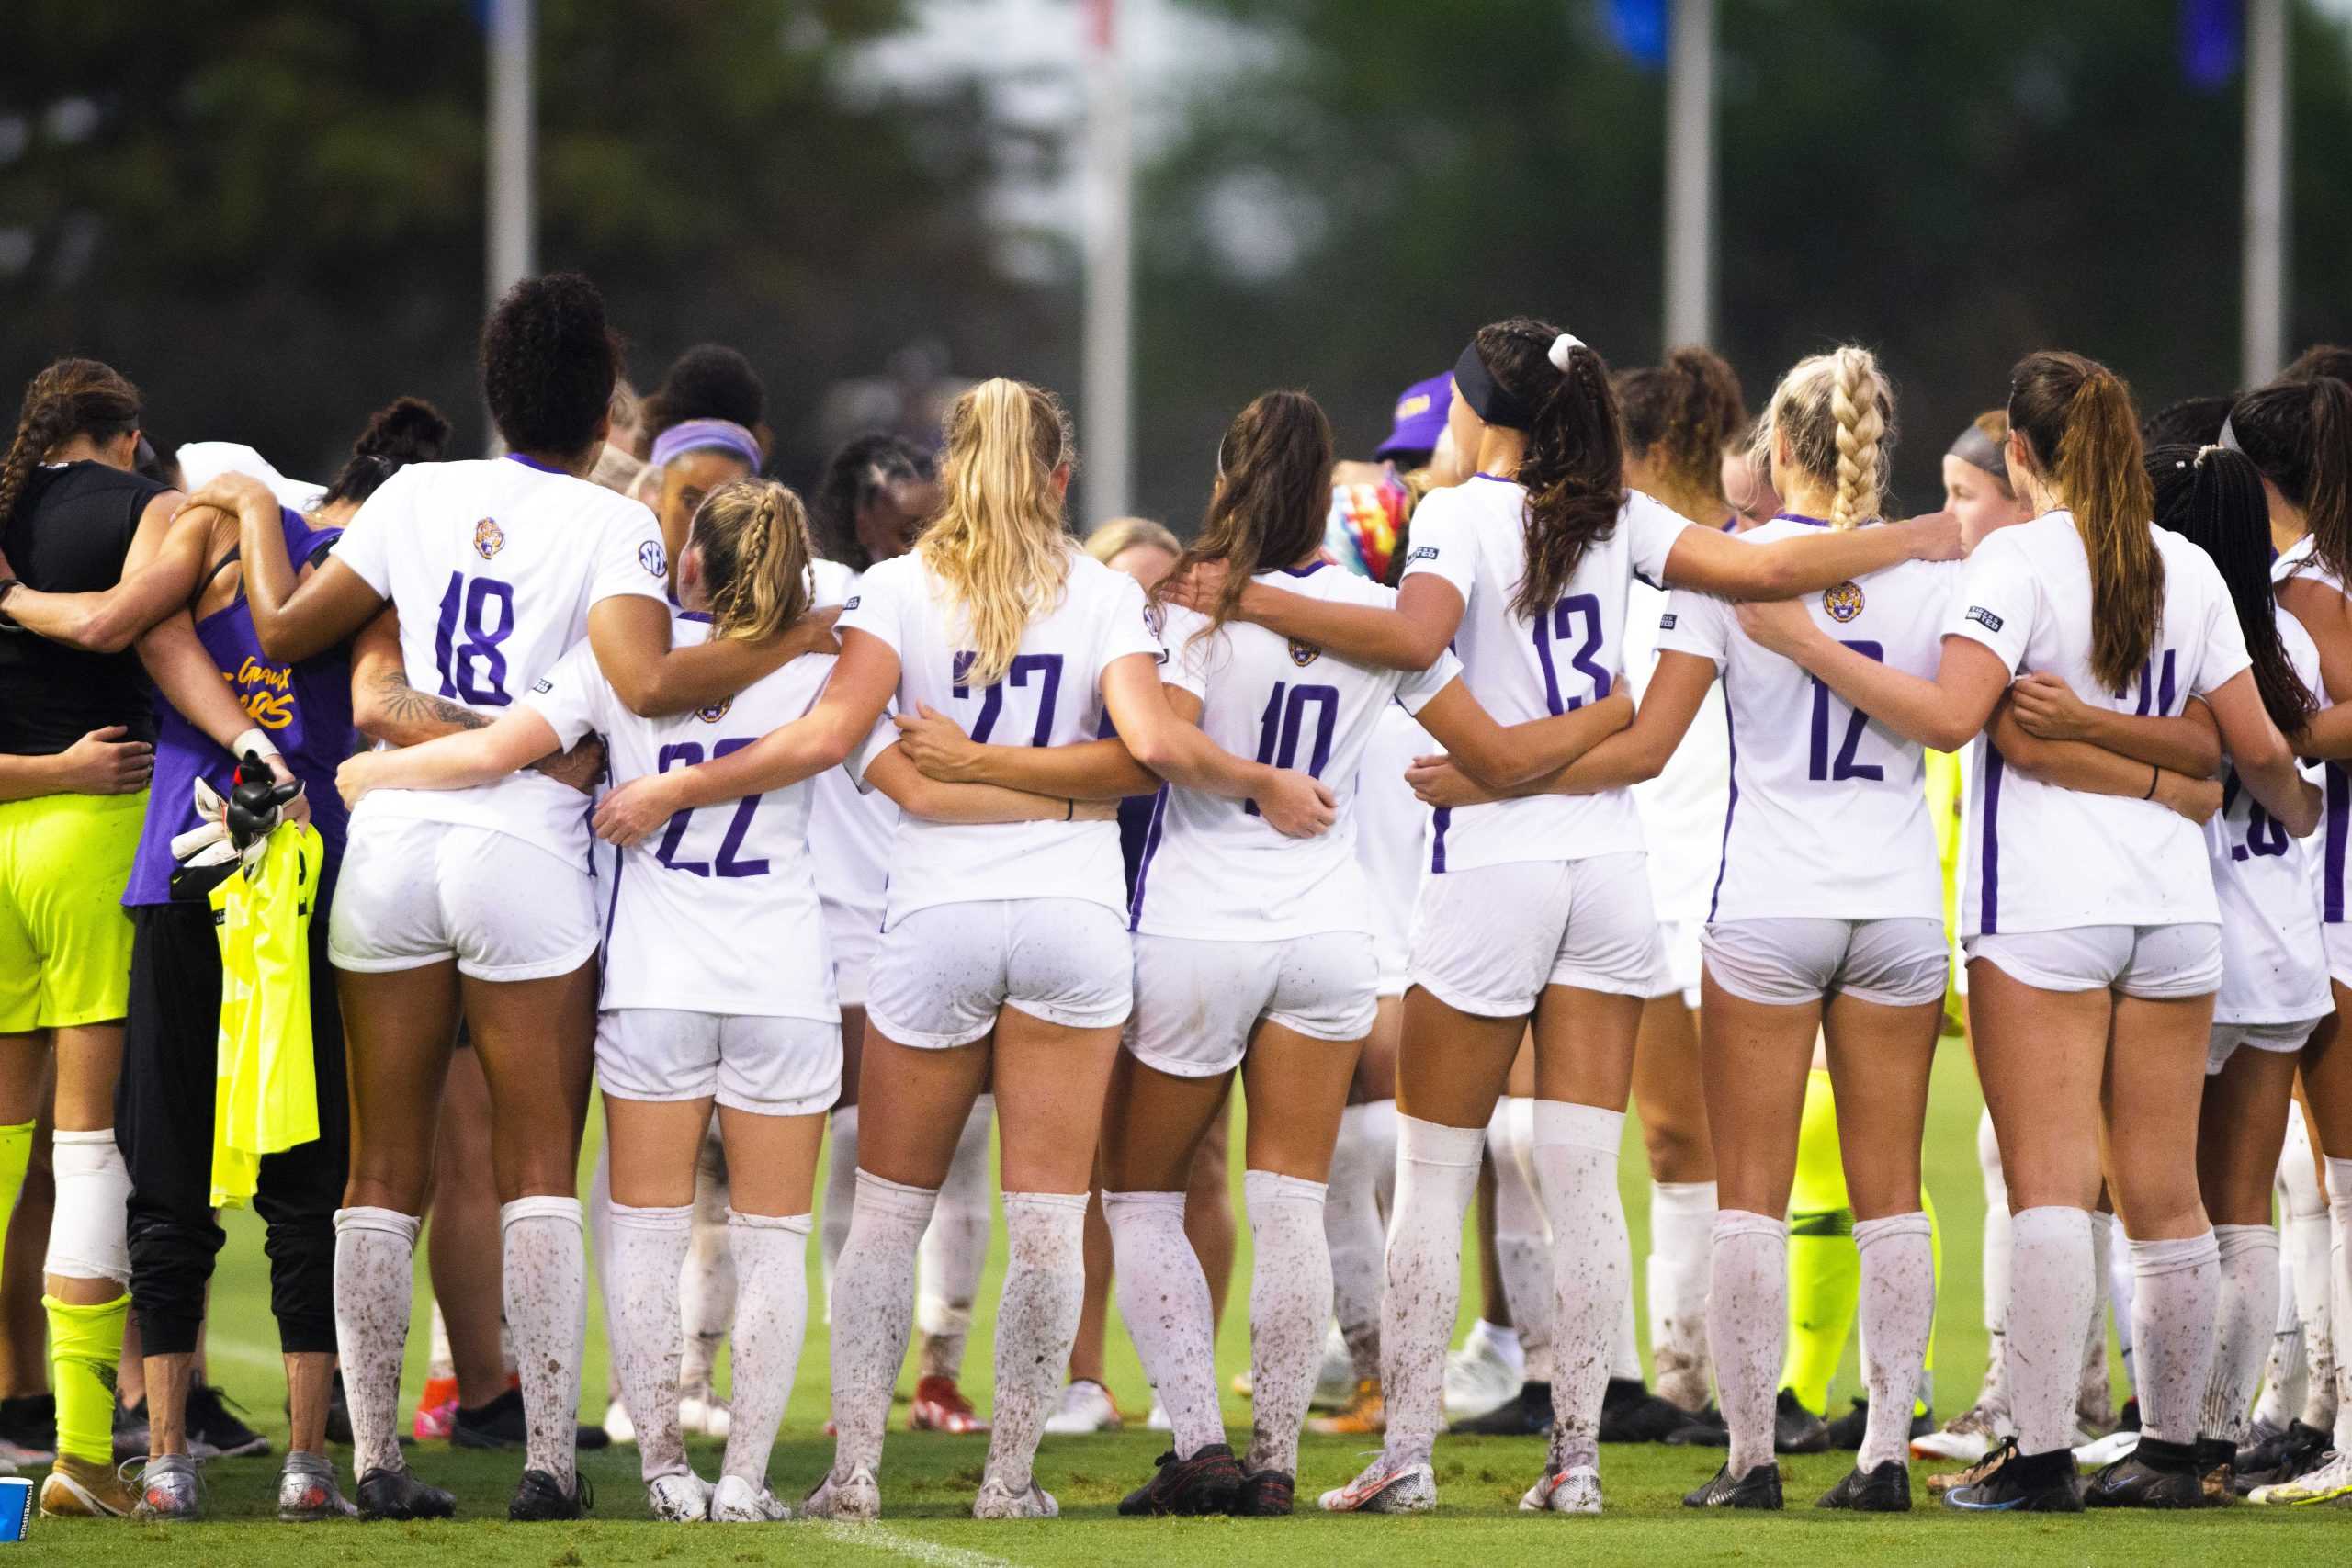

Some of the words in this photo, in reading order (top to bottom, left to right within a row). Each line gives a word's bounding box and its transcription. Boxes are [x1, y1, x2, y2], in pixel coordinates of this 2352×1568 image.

[435, 570, 514, 707] 18
[1532, 593, 1611, 716] 13
[1244, 681, 1339, 817] 10
[1809, 640, 1883, 781] 12
[655, 737, 770, 878] 22
